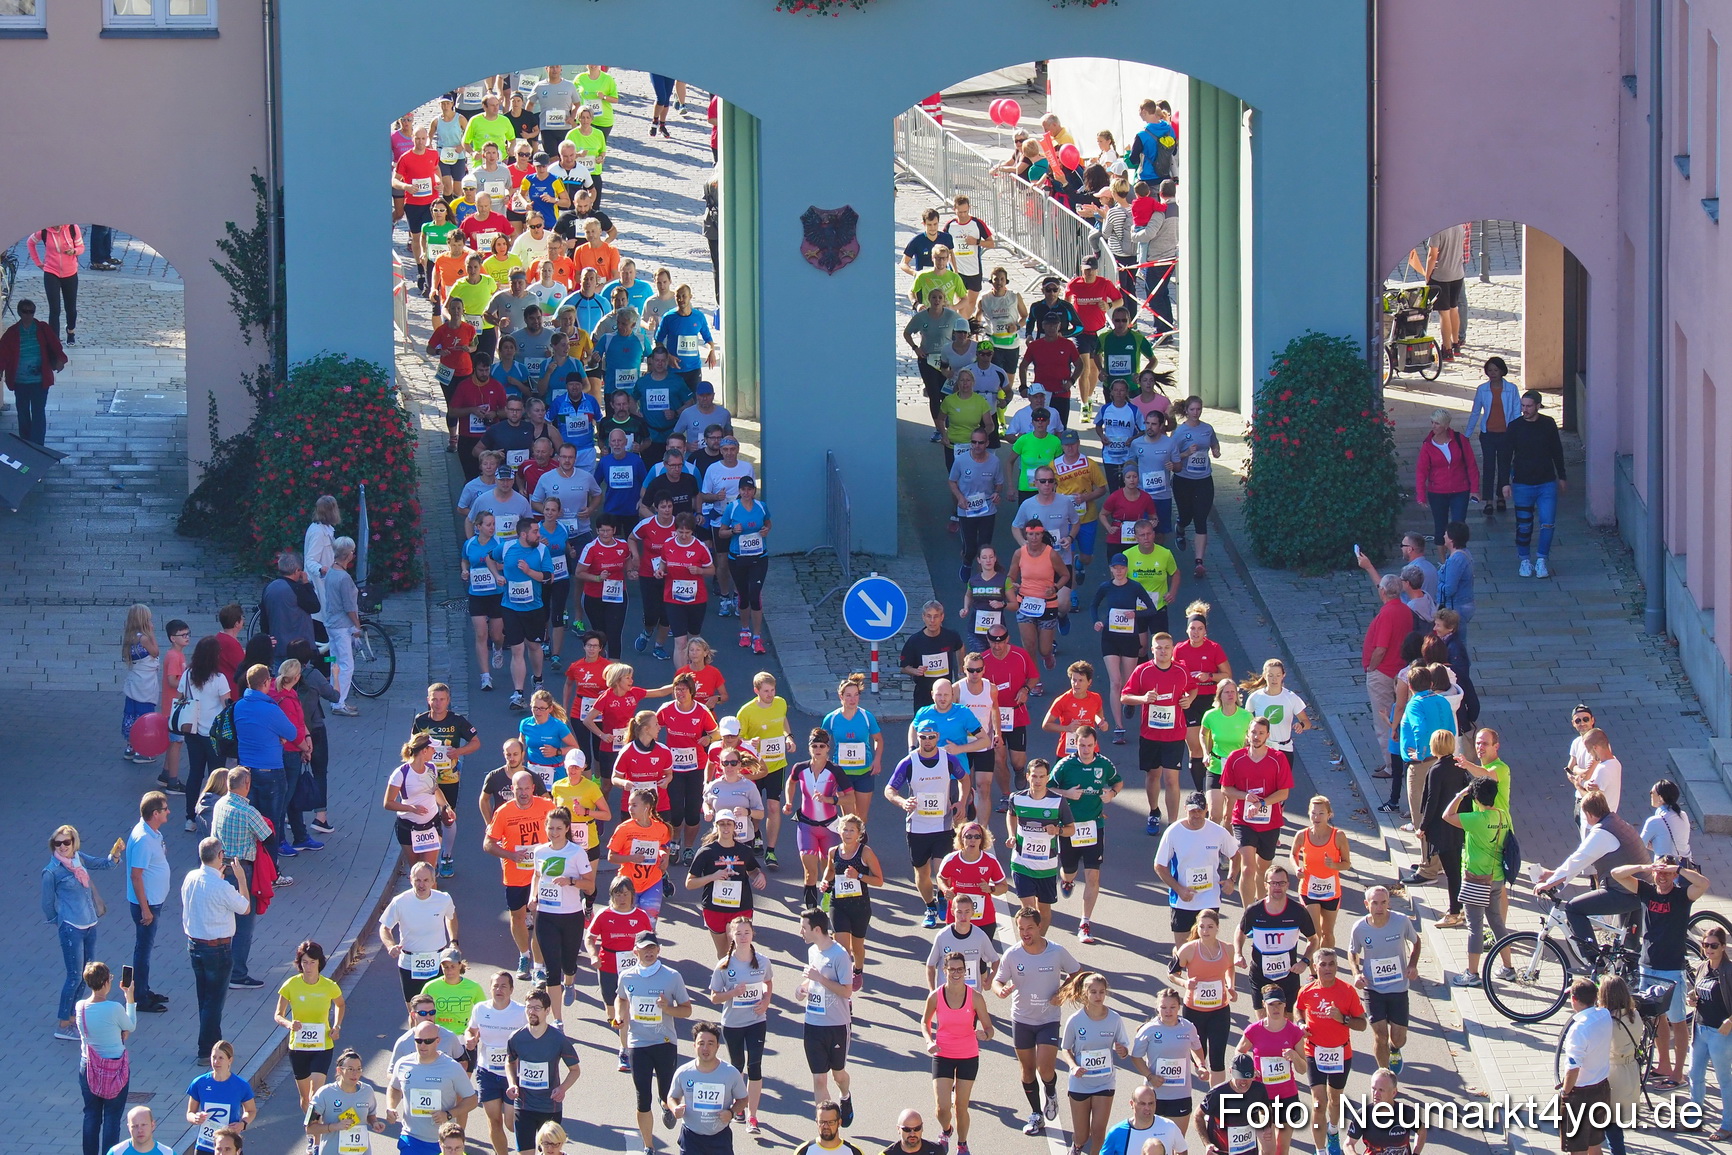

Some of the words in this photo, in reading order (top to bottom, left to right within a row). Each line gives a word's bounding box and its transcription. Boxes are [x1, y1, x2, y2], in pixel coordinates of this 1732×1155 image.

[680, 340, 696, 348] 3116
[569, 421, 586, 429] 3099
[612, 472, 630, 480] 2568
[1145, 477, 1163, 485] 2496
[742, 539, 760, 548] 2086
[553, 561, 564, 571] 087
[473, 573, 492, 583] 2085
[511, 587, 530, 595] 2084
[675, 586, 694, 594] 2243
[1023, 602, 1042, 611] 2097
[981, 617, 995, 625] 287
[1114, 614, 1129, 624] 306
[928, 659, 943, 668] 337
[1152, 710, 1171, 720] 2447
[438, 725, 455, 733] 2018
[766, 743, 781, 752] 293
[433, 752, 443, 760] 29
[846, 749, 857, 757] 81
[674, 754, 694, 762] 2210
[923, 799, 939, 808] 192
[519, 821, 540, 834] RUN
[1076, 827, 1092, 836] 172
[415, 832, 435, 843] 3006
[1026, 843, 1047, 852] 2120
[633, 864, 652, 879] SY
[1192, 872, 1208, 883] 234
[840, 881, 854, 890] 196
[1312, 882, 1332, 892] 2576
[540, 888, 558, 898] 2253
[722, 887, 733, 896] 97
[415, 959, 436, 968] 2593
[621, 957, 637, 968] 236
[1266, 961, 1287, 971] 2061
[1375, 963, 1397, 974] 2464
[738, 990, 759, 999] 030
[1200, 988, 1217, 998] 203
[638, 1003, 655, 1013] 277
[301, 1030, 318, 1040] 292
[491, 1054, 506, 1063] 237
[1085, 1056, 1106, 1067] 2067
[1318, 1052, 1339, 1062] 2242
[1160, 1065, 1182, 1075] 2069
[1268, 1063, 1285, 1073] 145
[523, 1068, 544, 1079] 2327
[697, 1090, 720, 1101] 3127
[420, 1096, 431, 1107] 20
[349, 1134, 361, 1143] 19
[1232, 1132, 1253, 1143] 2060
